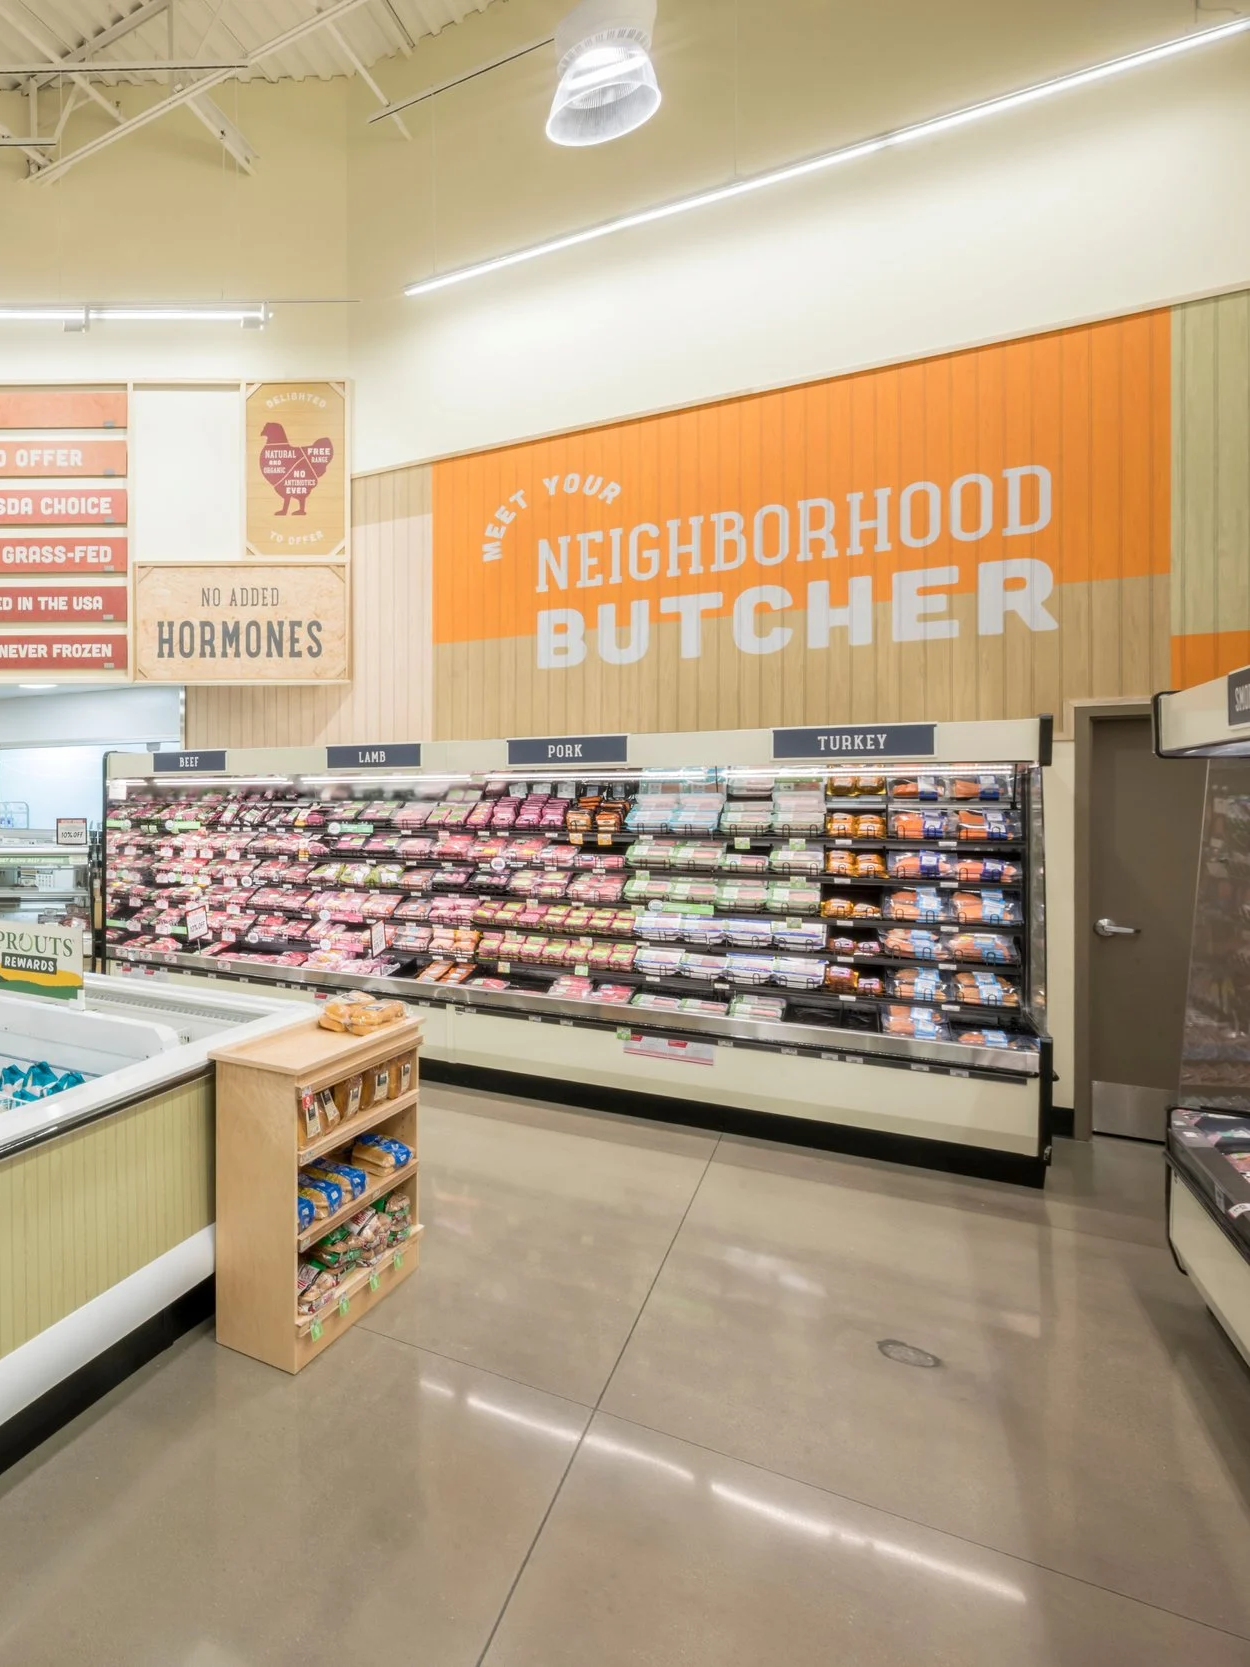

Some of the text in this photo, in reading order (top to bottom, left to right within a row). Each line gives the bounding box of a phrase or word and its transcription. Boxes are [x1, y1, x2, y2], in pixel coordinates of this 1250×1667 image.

[266, 392, 326, 409] DELIGHTED
[16, 449, 82, 466] OFFER
[265, 450, 296, 458] NATURAL
[40, 496, 112, 515] CHOICE
[482, 473, 621, 562] MEET YOUR
[270, 530, 324, 545] TO OFFER
[536, 465, 1052, 594] NEIGHBORHOOD
[2, 546, 112, 564] GRASS-FED
[18, 596, 33, 610] IN
[38, 596, 68, 610] THE
[72, 596, 102, 610] USA
[201, 587, 280, 607] NO ADDED
[536, 556, 1059, 669] BUTCHER
[157, 620, 323, 658] HORMONES
[52, 644, 112, 658] FROZEN
[817, 734, 887, 752] TURKEY
[358, 752, 386, 764] LAMB
[548, 744, 582, 760] PORK
[179, 756, 200, 768] BEEF
[4, 956, 54, 973] REWARDS
